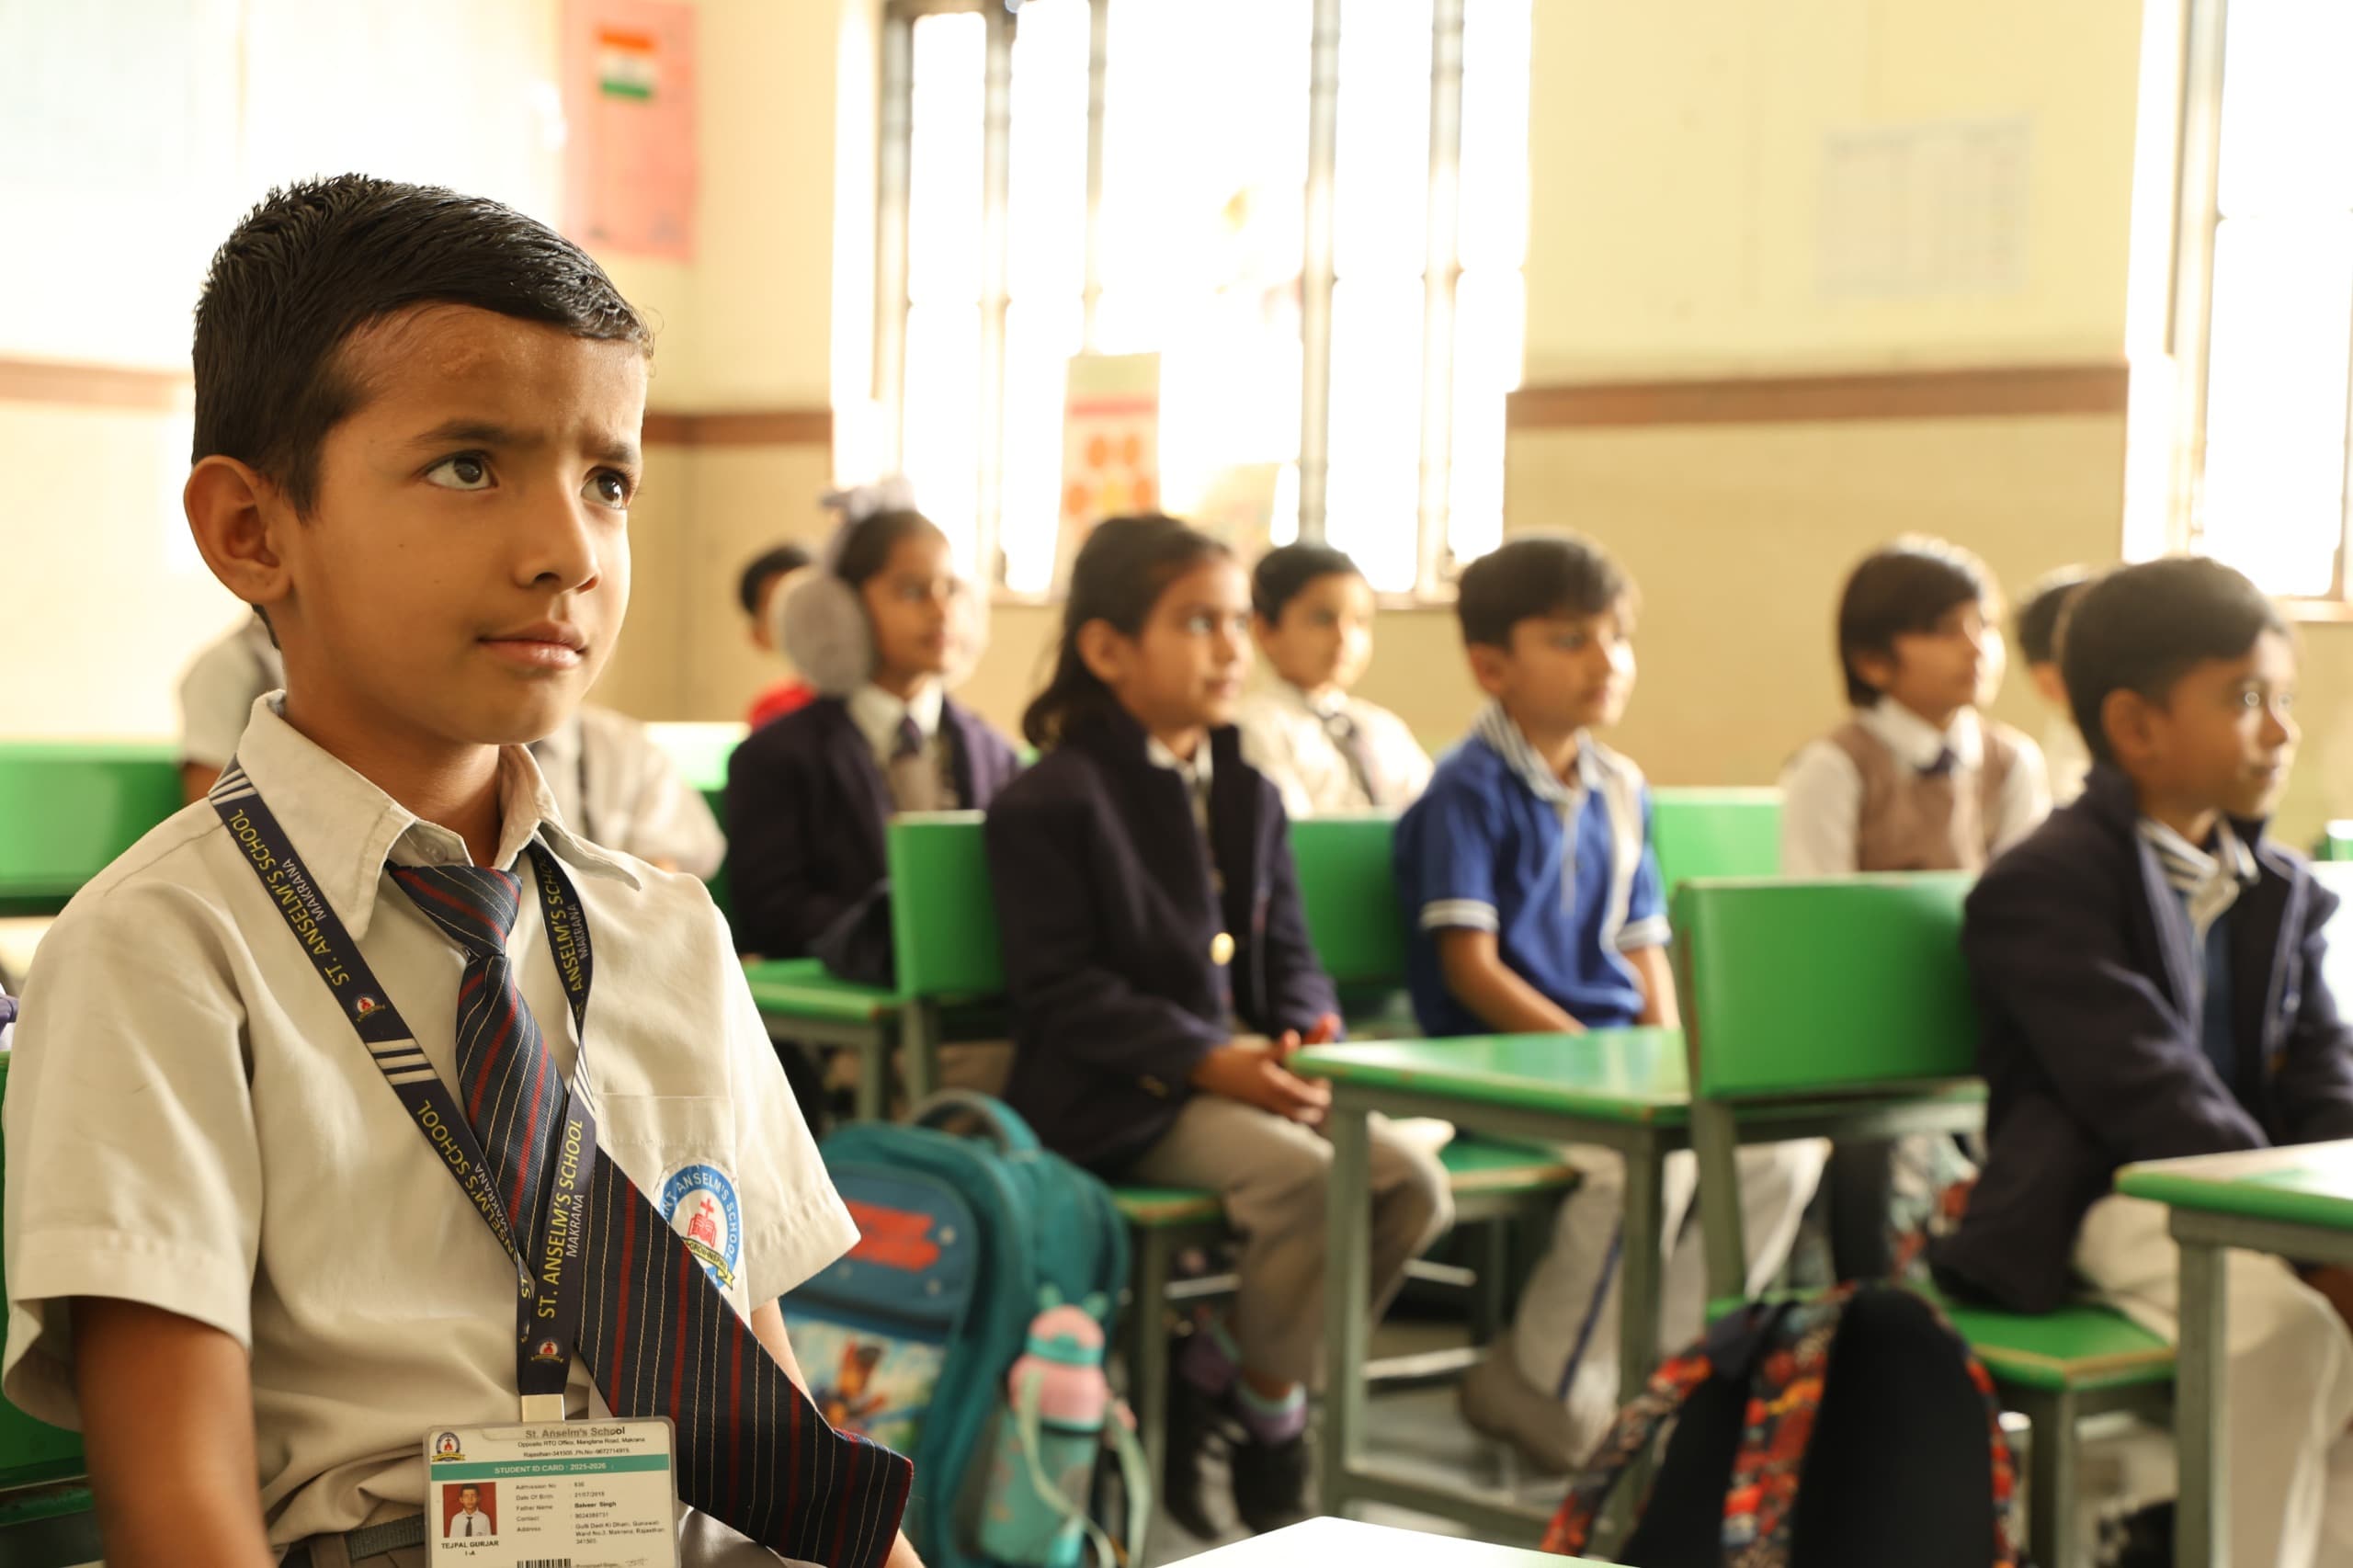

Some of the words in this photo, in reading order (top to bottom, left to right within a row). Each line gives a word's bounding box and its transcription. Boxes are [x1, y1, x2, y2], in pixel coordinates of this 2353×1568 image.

[229, 809, 276, 870] SCHOOL
[267, 869, 331, 955] ANSELM'S
[282, 858, 327, 921] MAKRANA
[550, 911, 584, 992] ANSELM'S
[567, 903, 588, 960] MAKRANA
[417, 1099, 471, 1176] SCHOOL
[560, 1119, 583, 1191] SCHOOL
[542, 1192, 571, 1286] ANSELM'S
[565, 1194, 584, 1258] MAKRANA
[676, 1172, 729, 1200] ANSELM'S
[726, 1202, 738, 1259] SCHOOL
[538, 1290, 559, 1318] ST.
[542, 1427, 587, 1438] Anselm's
[591, 1426, 625, 1437] School
[494, 1466, 530, 1474] STUDENT
[570, 1462, 607, 1471] 2025-2026
[441, 1541, 468, 1550] TEJPAL
[470, 1540, 499, 1548] GURJAR
